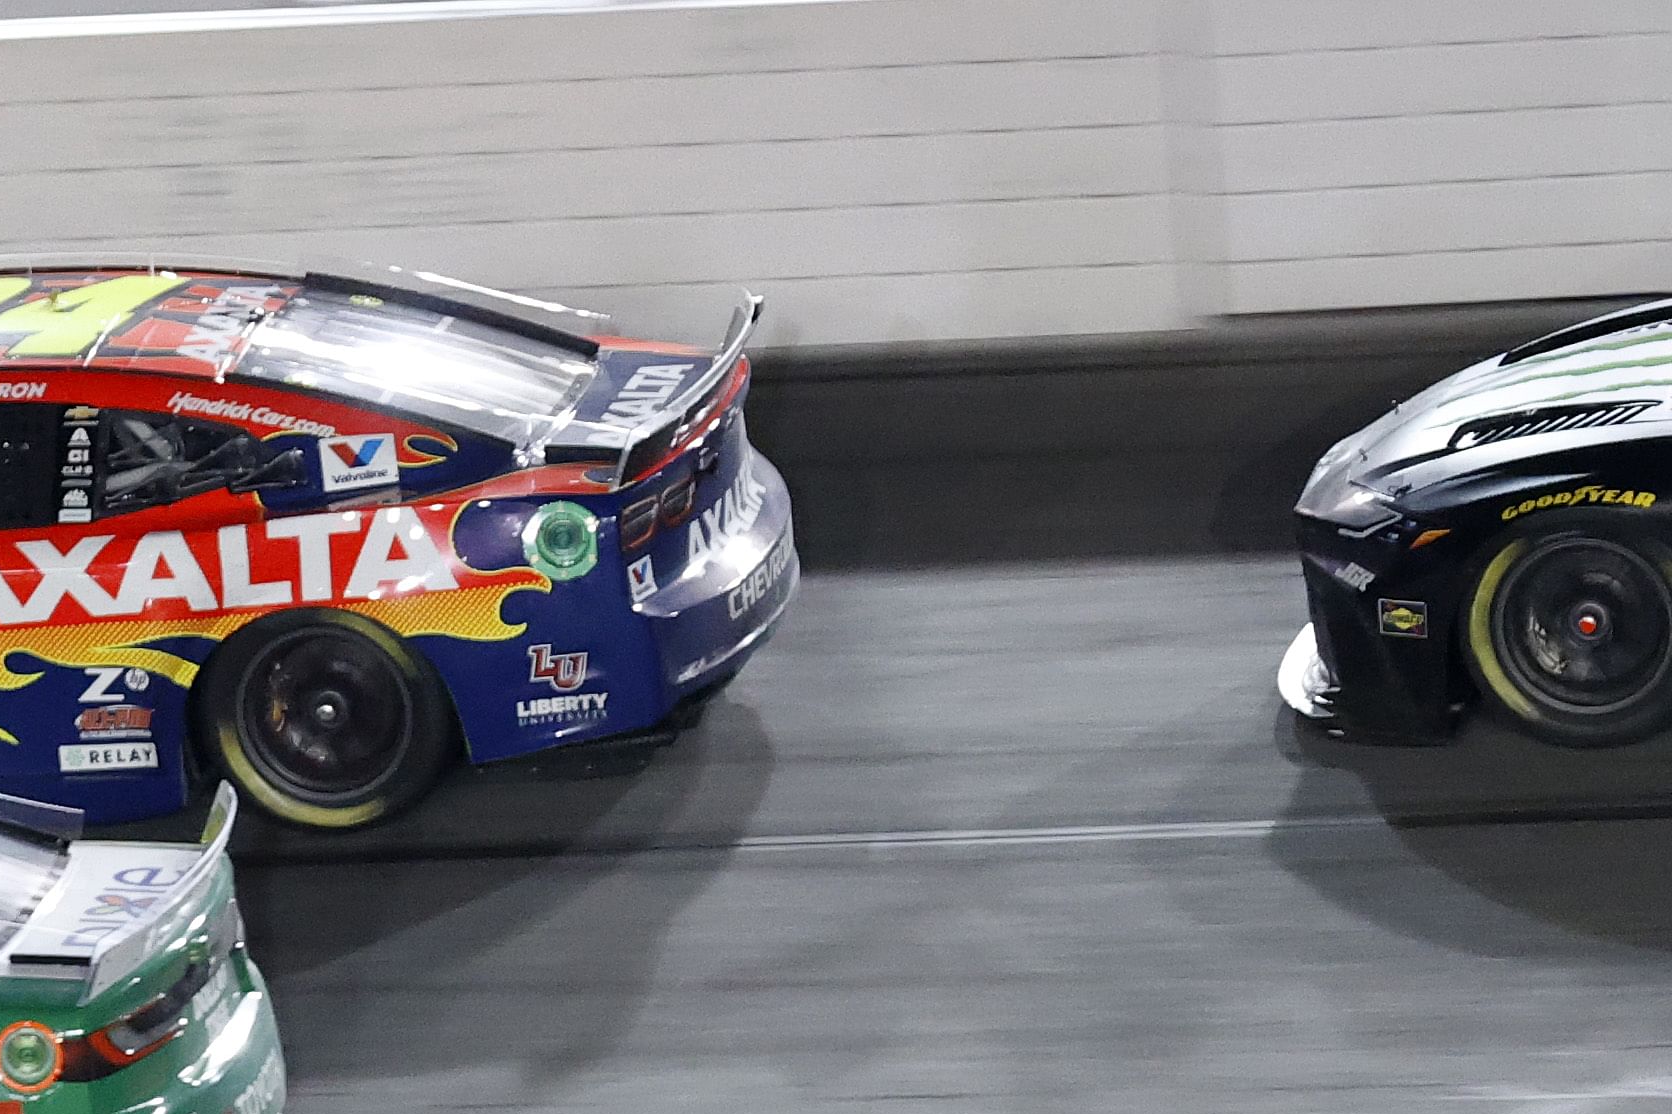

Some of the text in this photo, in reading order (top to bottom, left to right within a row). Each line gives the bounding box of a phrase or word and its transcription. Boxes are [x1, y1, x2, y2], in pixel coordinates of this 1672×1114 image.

[1501, 484, 1658, 522] GOODYEAR
[516, 692, 609, 718] LIBERTY
[88, 748, 153, 764] RELAY
